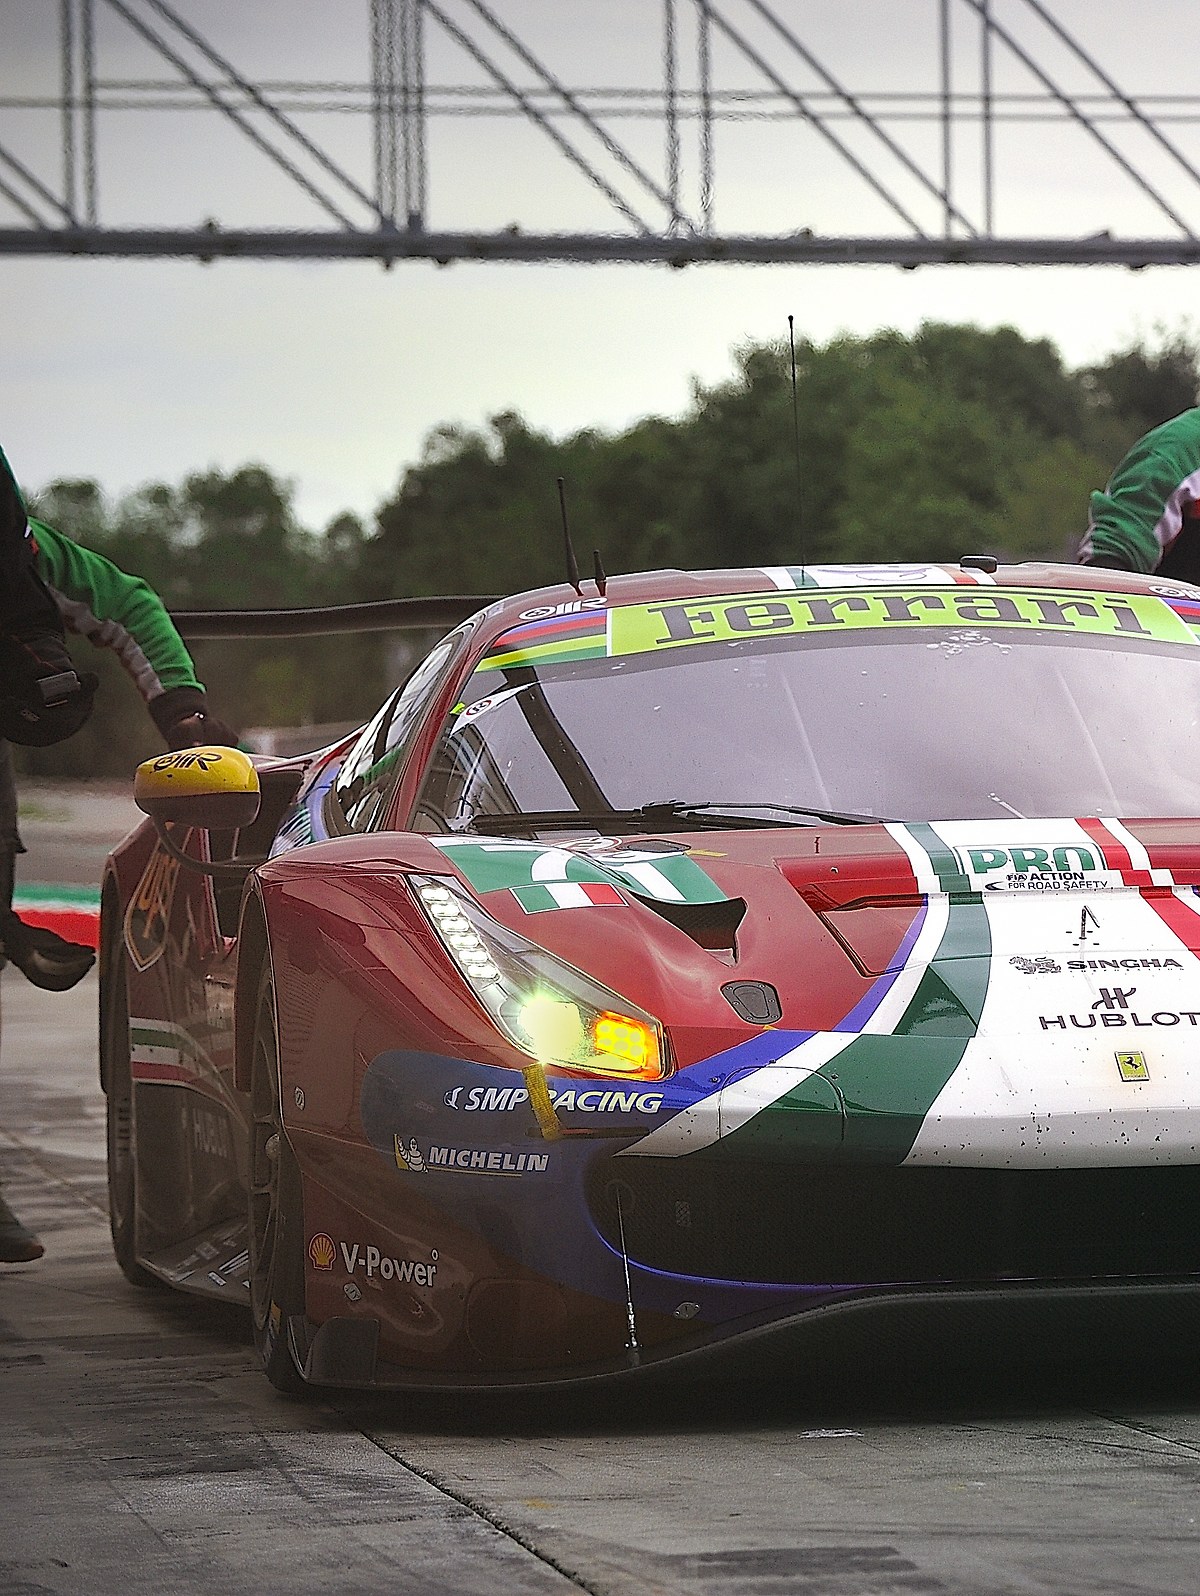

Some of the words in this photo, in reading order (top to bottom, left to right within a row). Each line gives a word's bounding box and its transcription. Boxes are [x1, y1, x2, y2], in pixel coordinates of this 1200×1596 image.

[647, 594, 1152, 645] Ferrari
[967, 846, 1096, 874] PRO
[1008, 882, 1026, 890] FOR
[1027, 881, 1061, 890] ROAD
[1063, 880, 1108, 890] SAFETY
[1029, 872, 1085, 881] ACTION
[1066, 958, 1184, 970] SINGHA
[464, 1086, 529, 1112] SMP
[429, 1146, 549, 1171] MICHELIN
[340, 1241, 438, 1287] V-Power
